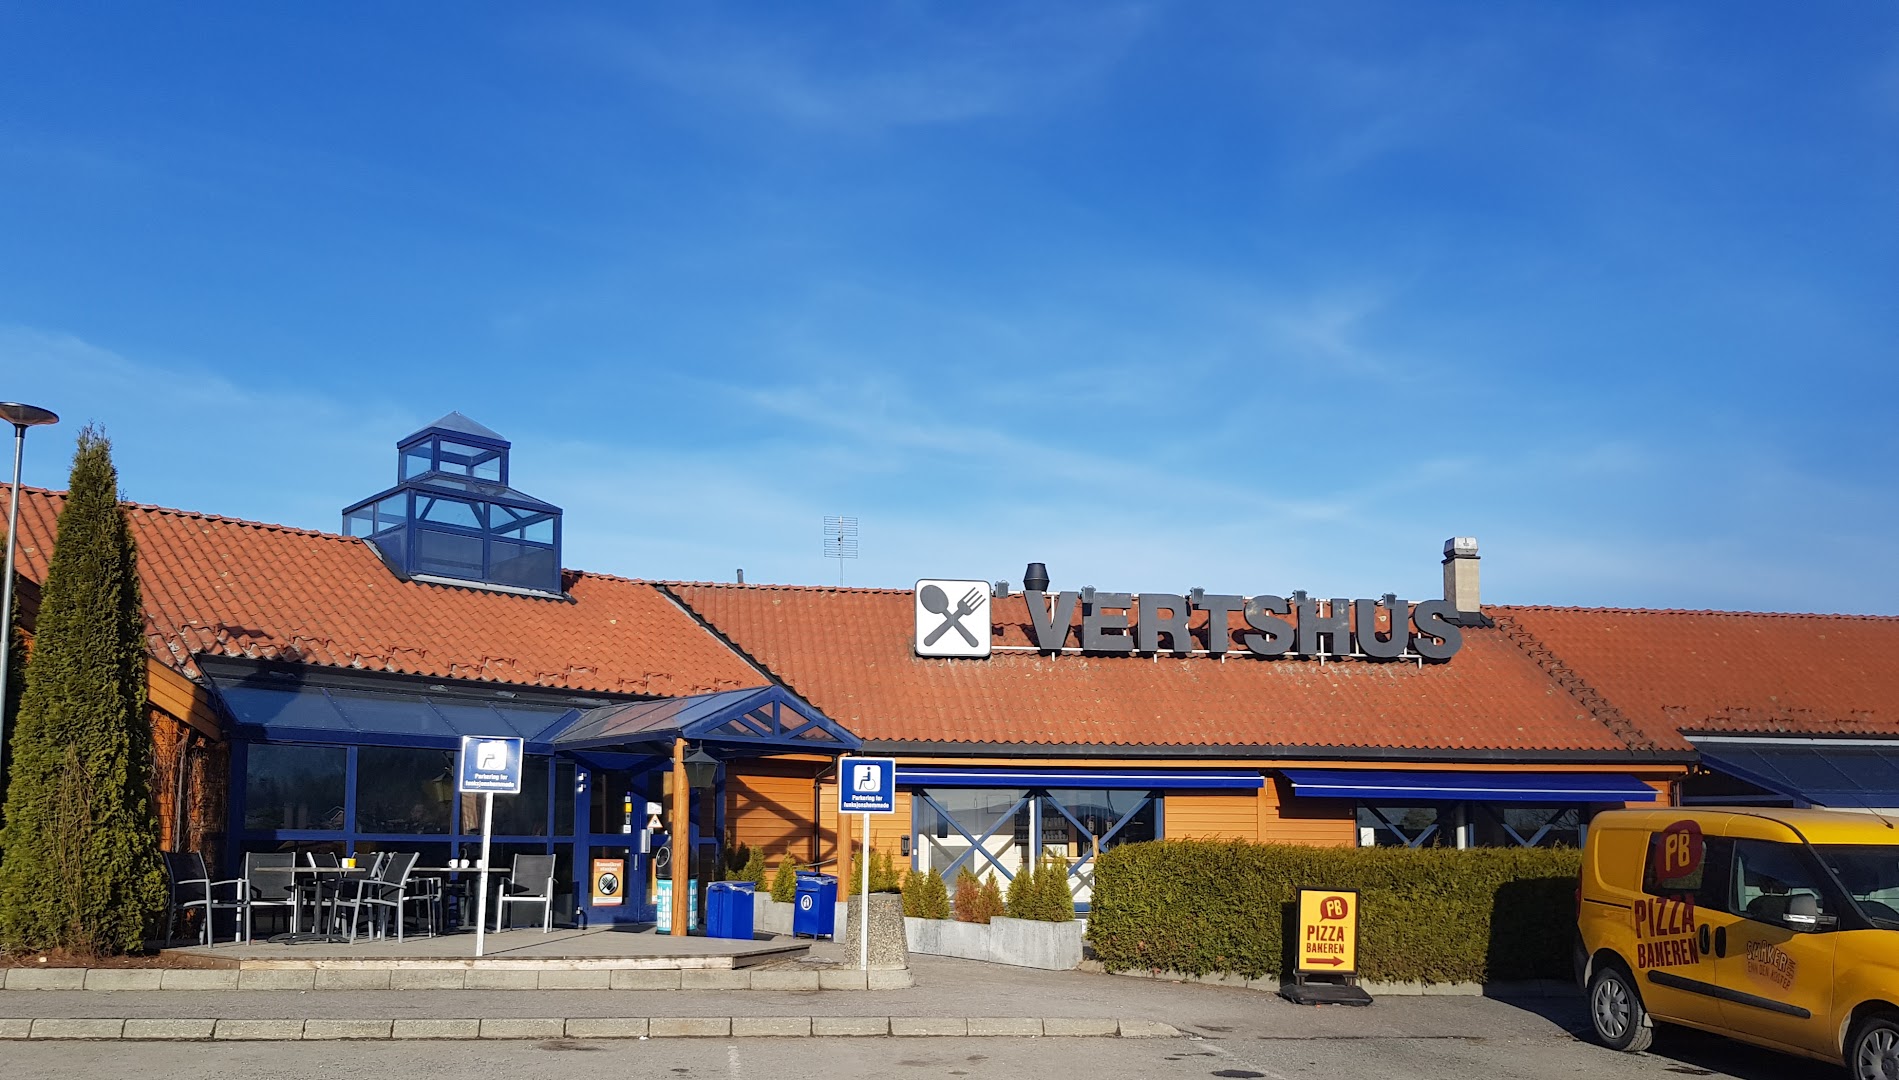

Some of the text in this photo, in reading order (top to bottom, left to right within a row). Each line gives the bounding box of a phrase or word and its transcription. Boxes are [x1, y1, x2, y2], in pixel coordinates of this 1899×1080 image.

[1023, 590, 1463, 659] VERTSHUS
[474, 773, 500, 781] Parkering
[851, 794, 875, 802] Parkering
[1665, 829, 1690, 872] PB
[1326, 899, 1343, 917] PB
[1635, 893, 1696, 939] PIZZA
[1307, 924, 1345, 942] PIZZA
[1306, 943, 1345, 954] BAKEREN
[1637, 937, 1700, 969] BAKEREN
[1746, 940, 1789, 973] SMAKER
